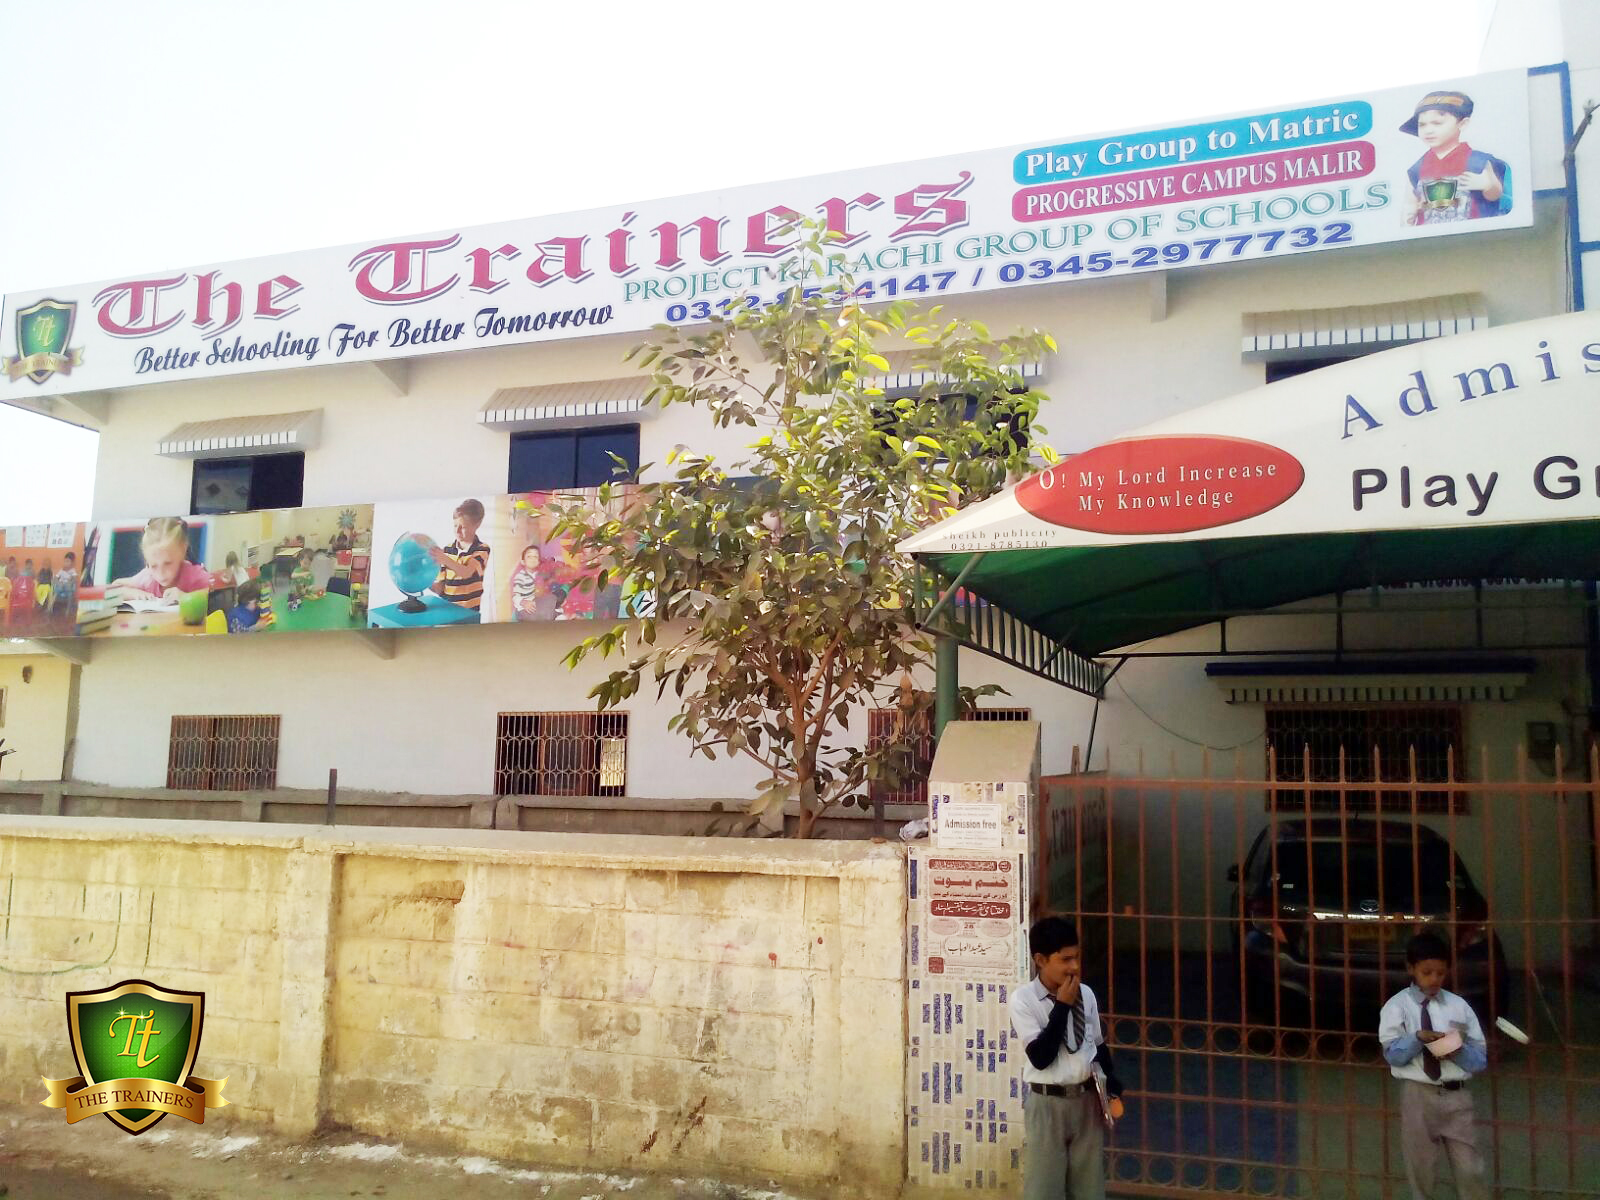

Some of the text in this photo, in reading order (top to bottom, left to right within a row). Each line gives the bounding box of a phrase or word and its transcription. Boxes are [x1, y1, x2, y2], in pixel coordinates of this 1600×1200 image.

[1026, 108, 1360, 177] Play Group to Matric
[1026, 149, 1364, 216] PROGRESSIVE CAMPUS MALIR
[92, 170, 976, 341] The Trainers
[624, 264, 768, 302] PROJECT
[955, 221, 1095, 261] GROUP
[1107, 213, 1163, 240] OF
[1175, 182, 1391, 234] SCHOOLS
[999, 221, 1353, 284] 0345-2977732
[134, 305, 615, 374] Better Schooling For Better Tomorrow
[1079, 471, 1105, 491] My
[1118, 466, 1166, 486] Lord
[1179, 463, 1277, 483] Increase
[1079, 488, 1234, 515] My Knowledge
[1353, 465, 1498, 517] Play
[942, 529, 1057, 541] sheikh publicity
[944, 819, 997, 829] Admission free
